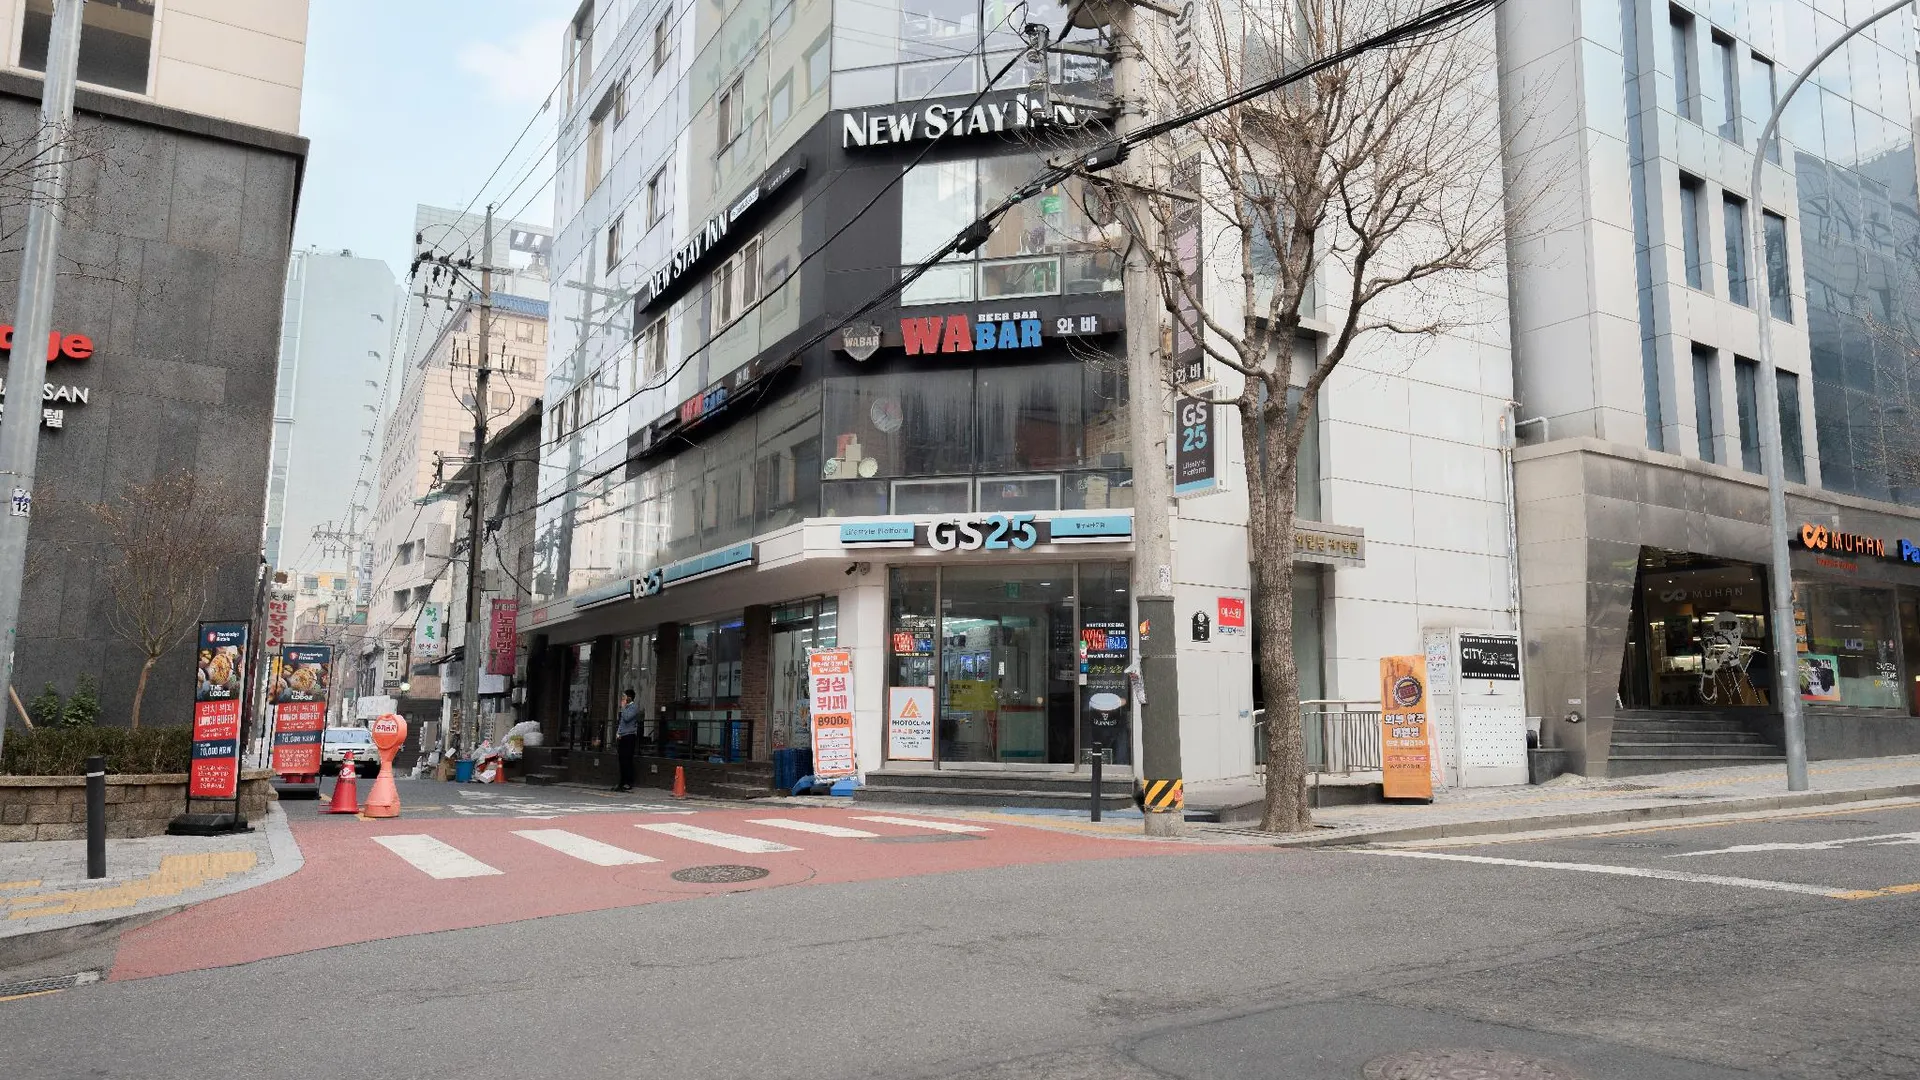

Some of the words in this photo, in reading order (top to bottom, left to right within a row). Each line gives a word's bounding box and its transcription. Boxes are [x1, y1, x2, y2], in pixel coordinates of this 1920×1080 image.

[843, 111, 917, 148] NEW
[924, 104, 1007, 139] STAY
[649, 259, 672, 303] NEW
[673, 231, 704, 279] STAY
[705, 209, 728, 251] INN
[978, 313, 1009, 321] BEER
[1013, 311, 1037, 319] BAR
[843, 337, 879, 347] WABAR
[1182, 402, 1207, 427] GS
[1182, 424, 1208, 452] 25
[16, 502, 28, 512] 12
[927, 514, 1037, 551] GS25
[1831, 531, 1885, 557] MUHAN
[1692, 587, 1743, 598] MUHAN
[1462, 647, 1483, 659] CITY
[816, 677, 846, 692] 점심
